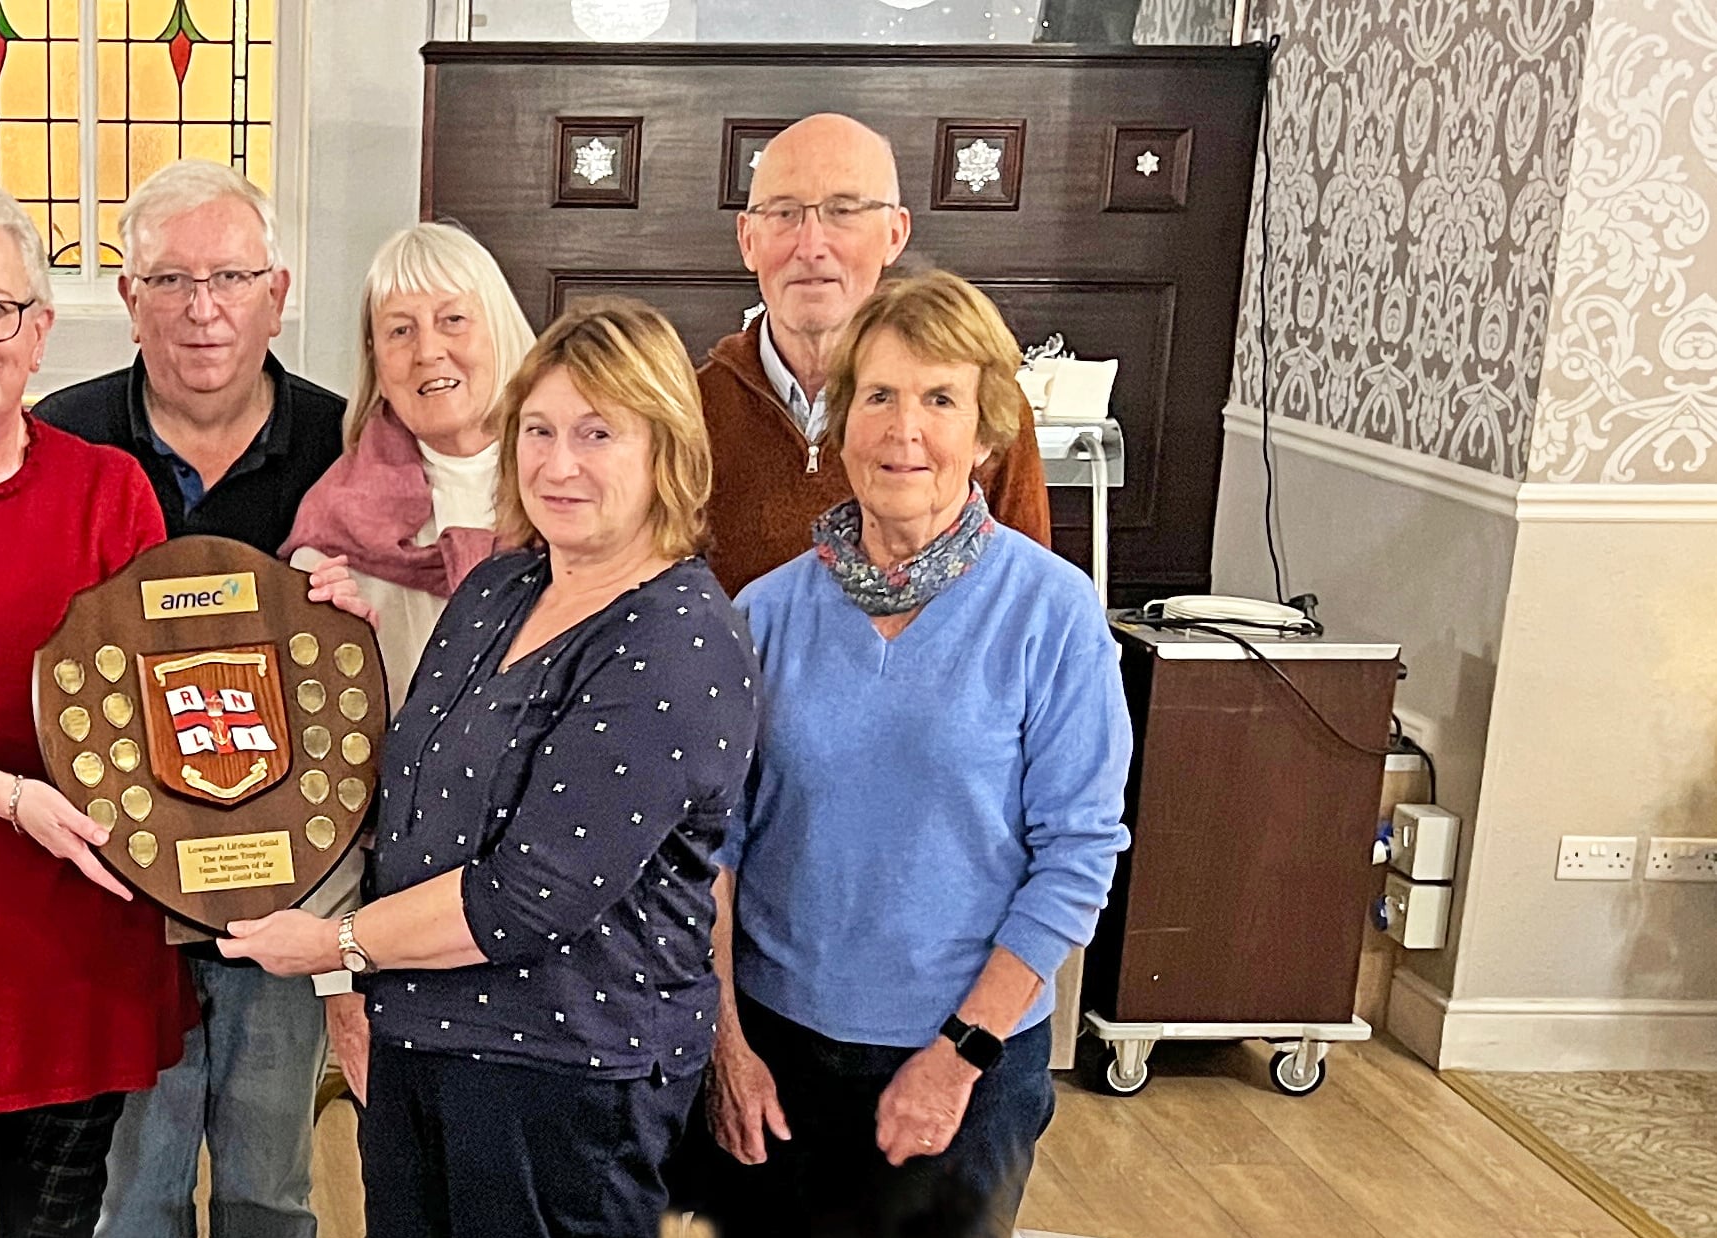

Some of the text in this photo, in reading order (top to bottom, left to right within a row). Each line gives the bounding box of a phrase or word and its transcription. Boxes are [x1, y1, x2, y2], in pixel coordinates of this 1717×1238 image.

[161, 590, 224, 610] amec
[180, 690, 247, 708] R N
[202, 855, 216, 864] The
[262, 860, 274, 868] the
